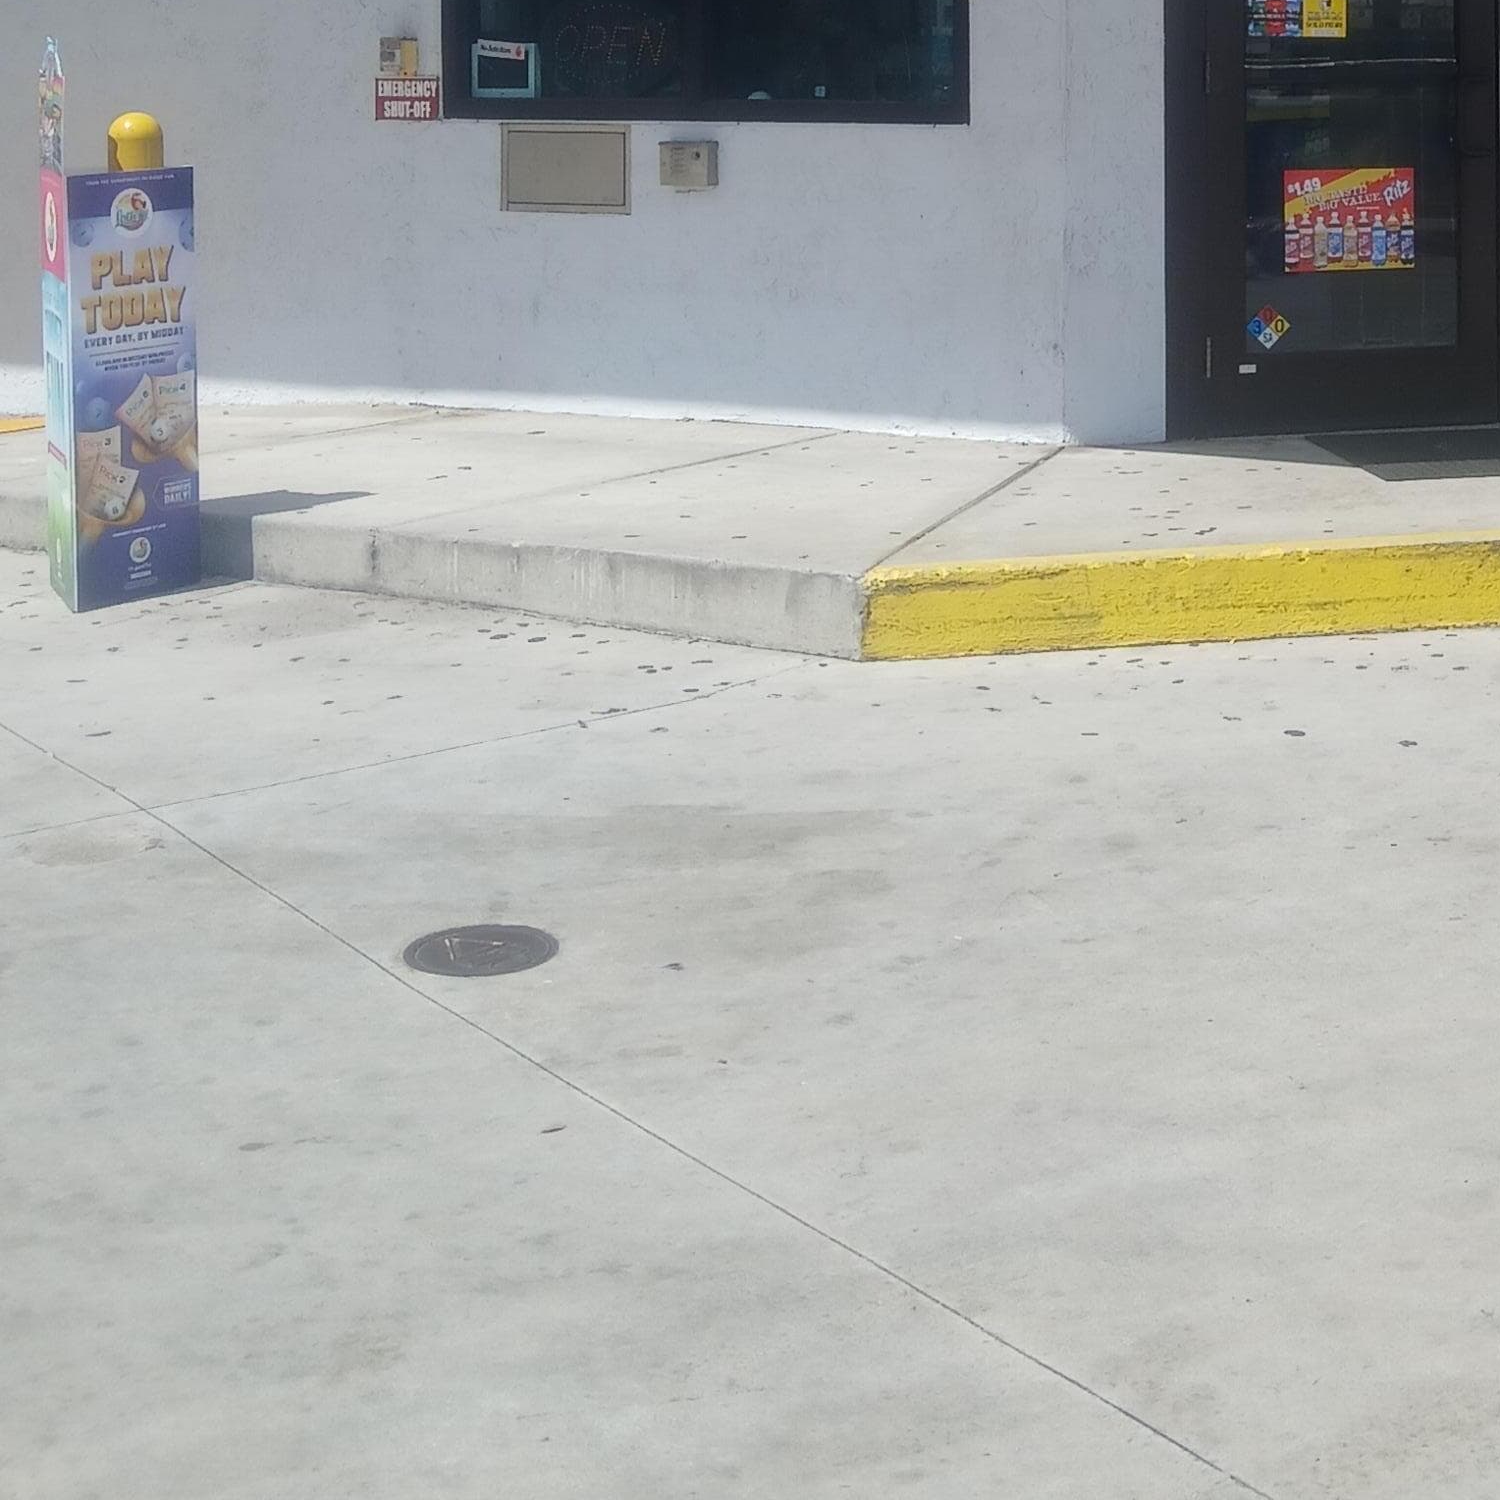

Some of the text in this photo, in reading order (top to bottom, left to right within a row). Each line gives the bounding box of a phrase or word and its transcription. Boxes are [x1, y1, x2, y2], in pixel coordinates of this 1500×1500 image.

[555, 25, 667, 67] OPEN
[378, 80, 437, 98] EMERGENCY
[383, 100, 432, 119] SHUT-OFF
[1287, 177, 1321, 197] $1.49
[1328, 184, 1368, 200] TASTE
[1383, 179, 1412, 207] Ritz
[92, 245, 174, 290] PLAY
[81, 286, 186, 335] TODAY
[1252, 319, 1262, 334] 3
[1275, 318, 1285, 332] 0
[84, 326, 184, 349] EVERY DAY, BY MIDDAY
